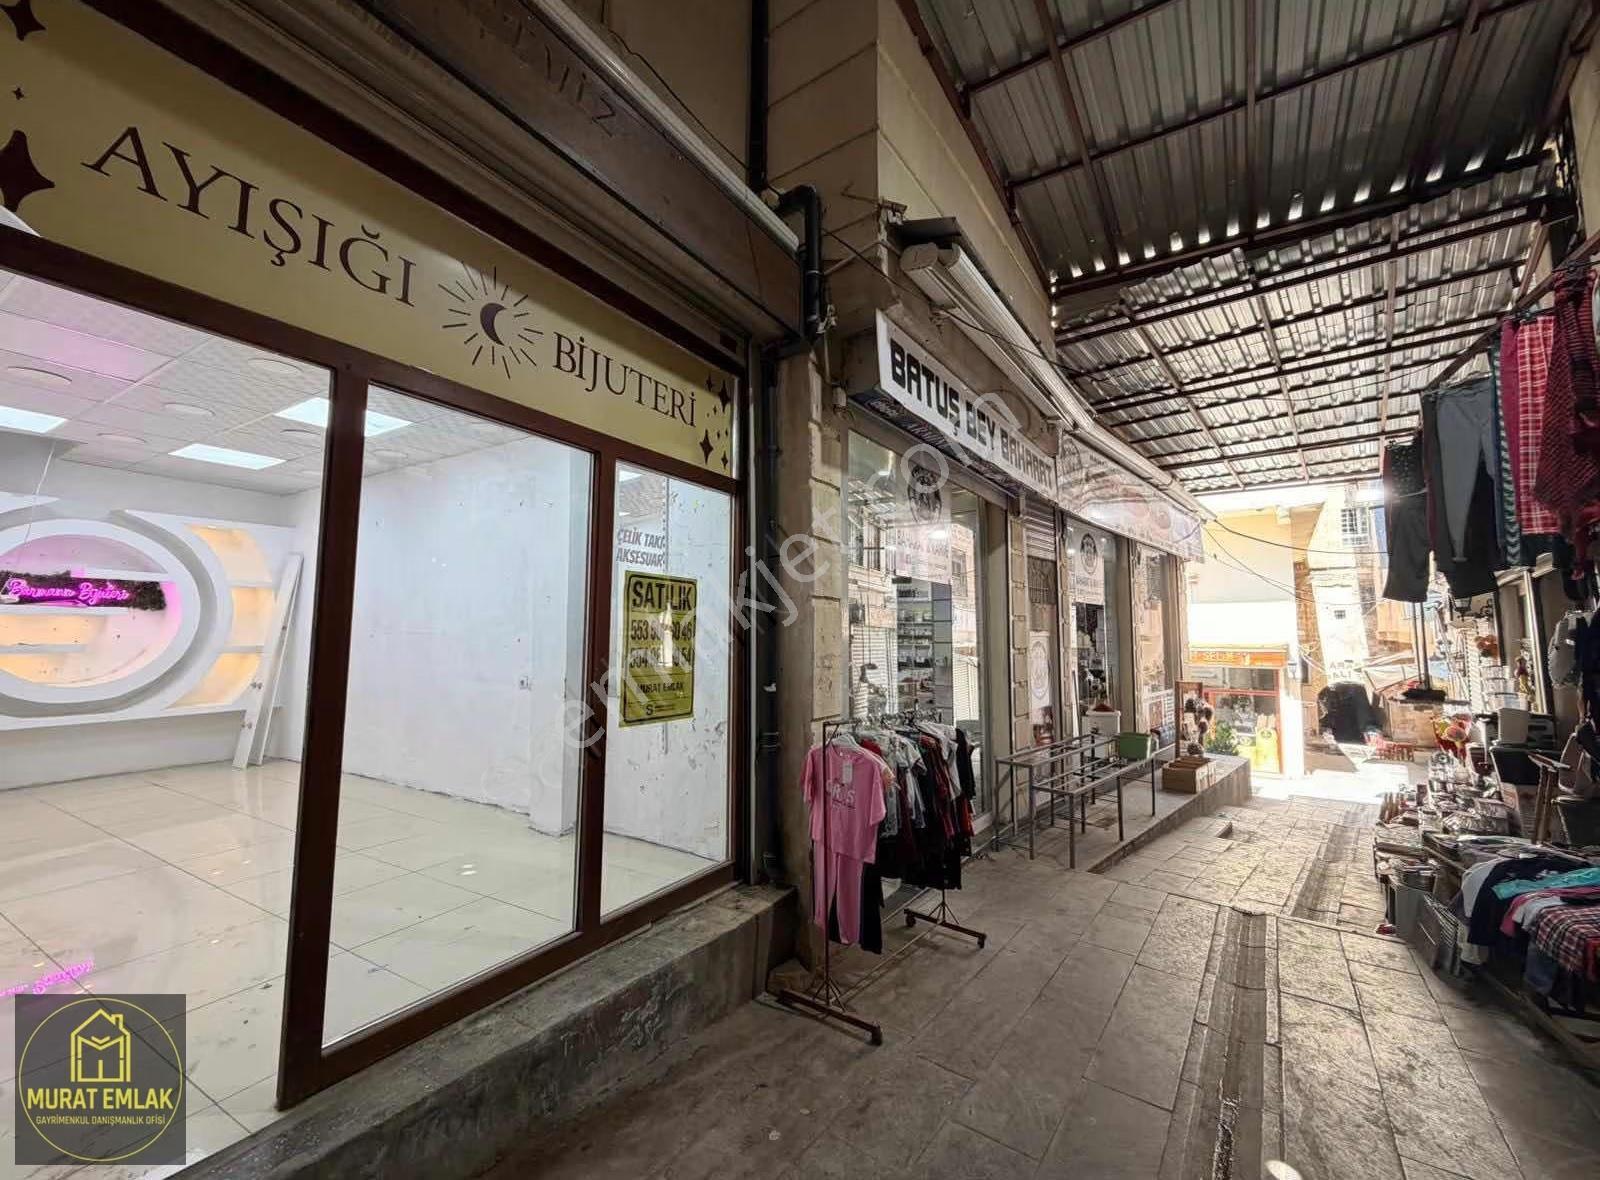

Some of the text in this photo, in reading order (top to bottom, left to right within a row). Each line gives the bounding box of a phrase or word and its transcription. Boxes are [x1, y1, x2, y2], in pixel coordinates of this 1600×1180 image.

[80, 125, 417, 307] AYIŞIĞI
[553, 332, 697, 428] BİJUTERİ
[890, 338, 961, 437] BATUŞ
[966, 399, 996, 450] BEY
[616, 548, 664, 567] AKSESUAR
[617, 526, 642, 546] ÇELİK
[632, 580, 692, 611] SATILIK
